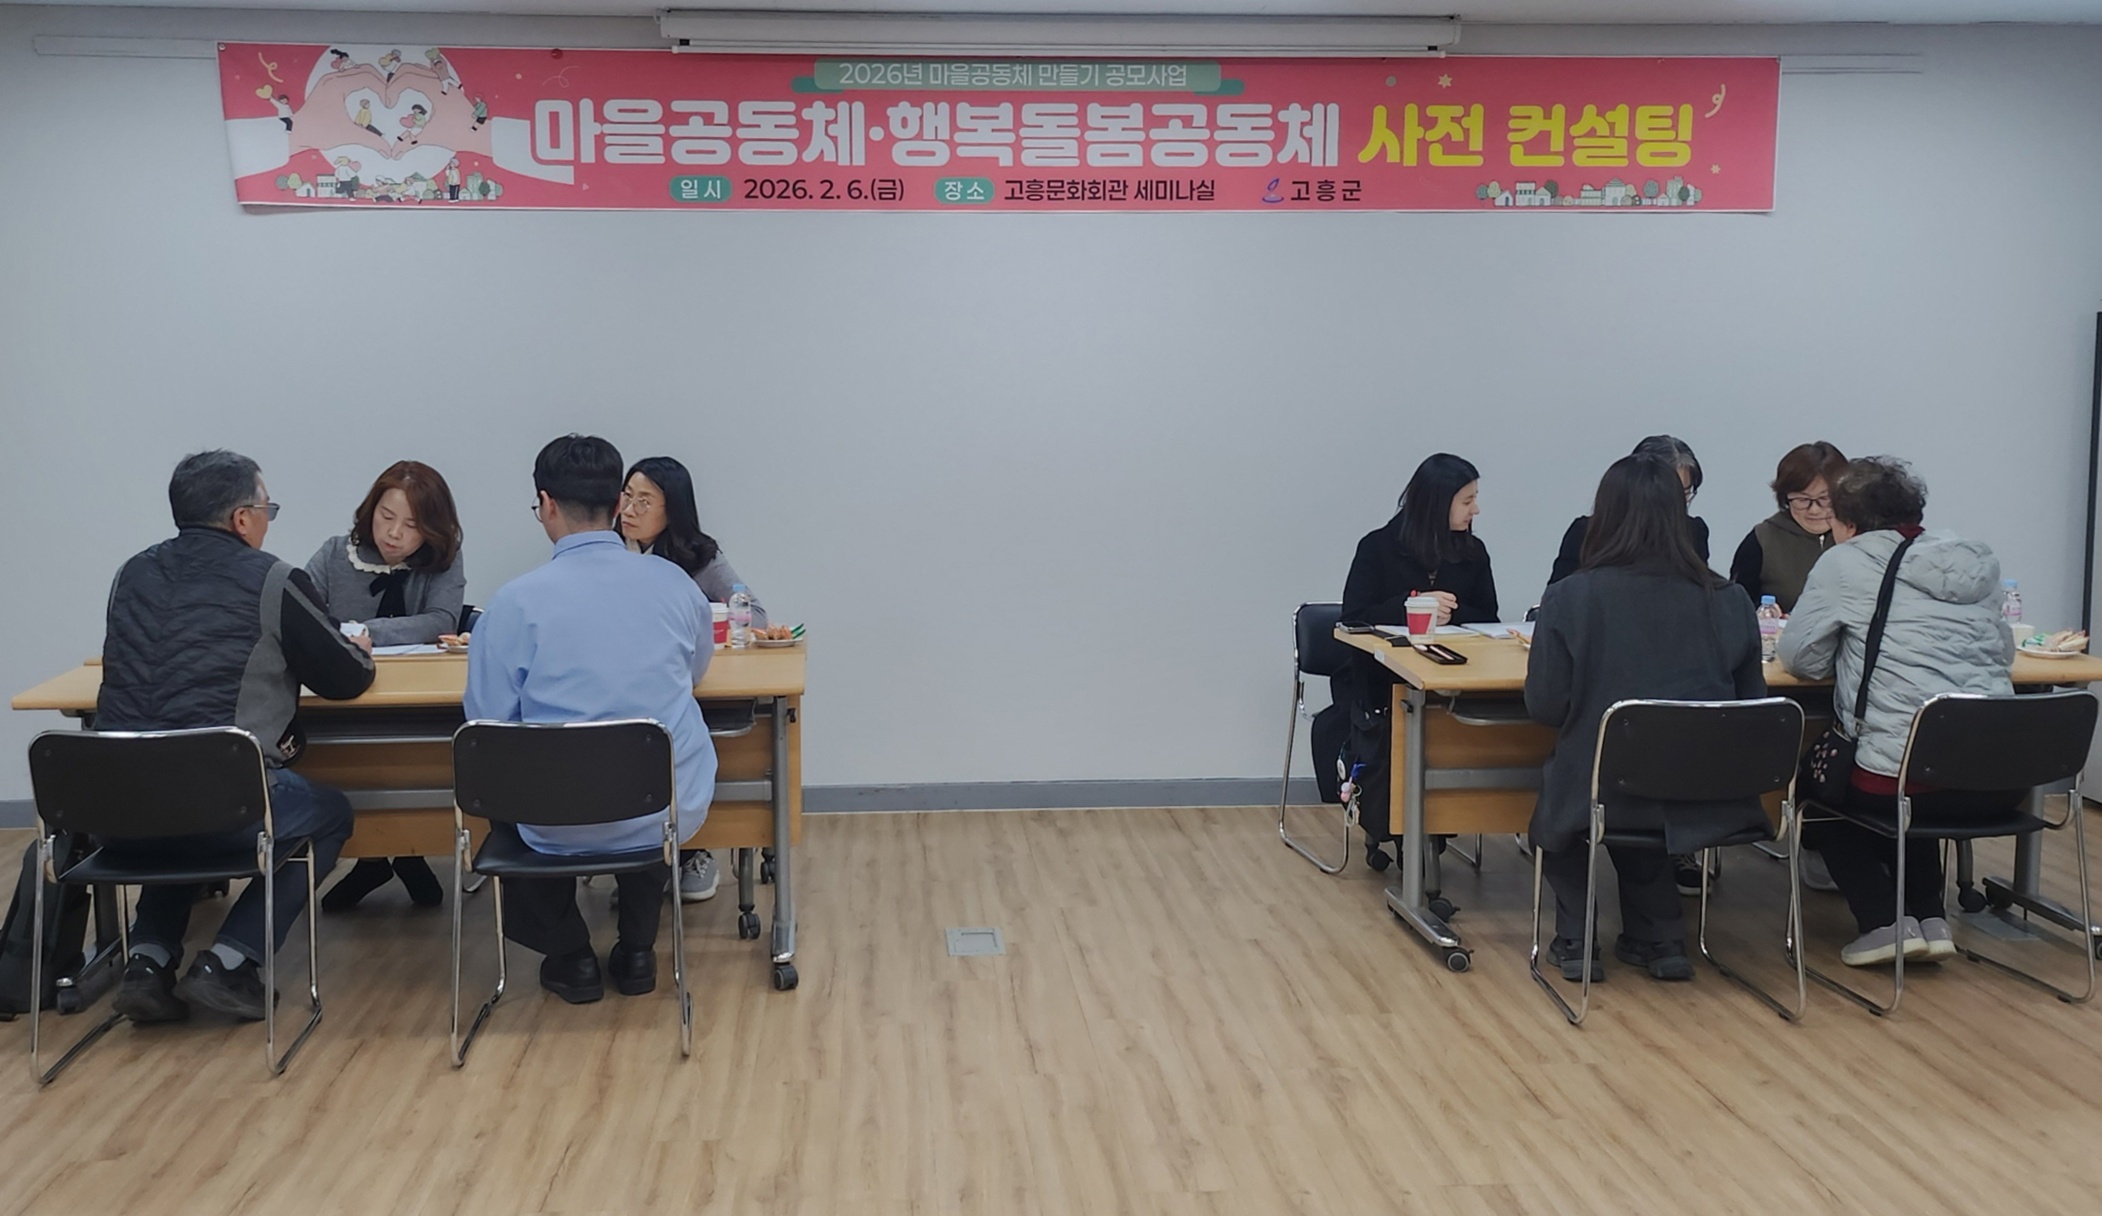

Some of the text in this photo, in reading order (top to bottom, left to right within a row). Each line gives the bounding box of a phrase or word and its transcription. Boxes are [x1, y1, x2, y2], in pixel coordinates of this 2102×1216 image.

[839, 62, 1187, 87] 2026년 마을공동체 만들기 공모사업
[1357, 103, 1485, 168] 사전
[1506, 103, 1694, 168] 컨설팅
[680, 179, 721, 199] 일시
[744, 178, 904, 201] 2026. 2. 6.(금)
[944, 180, 985, 201] 장소
[1004, 179, 1215, 202] 고흥문화회관 세미나실
[1291, 180, 1362, 202] 고흥군
